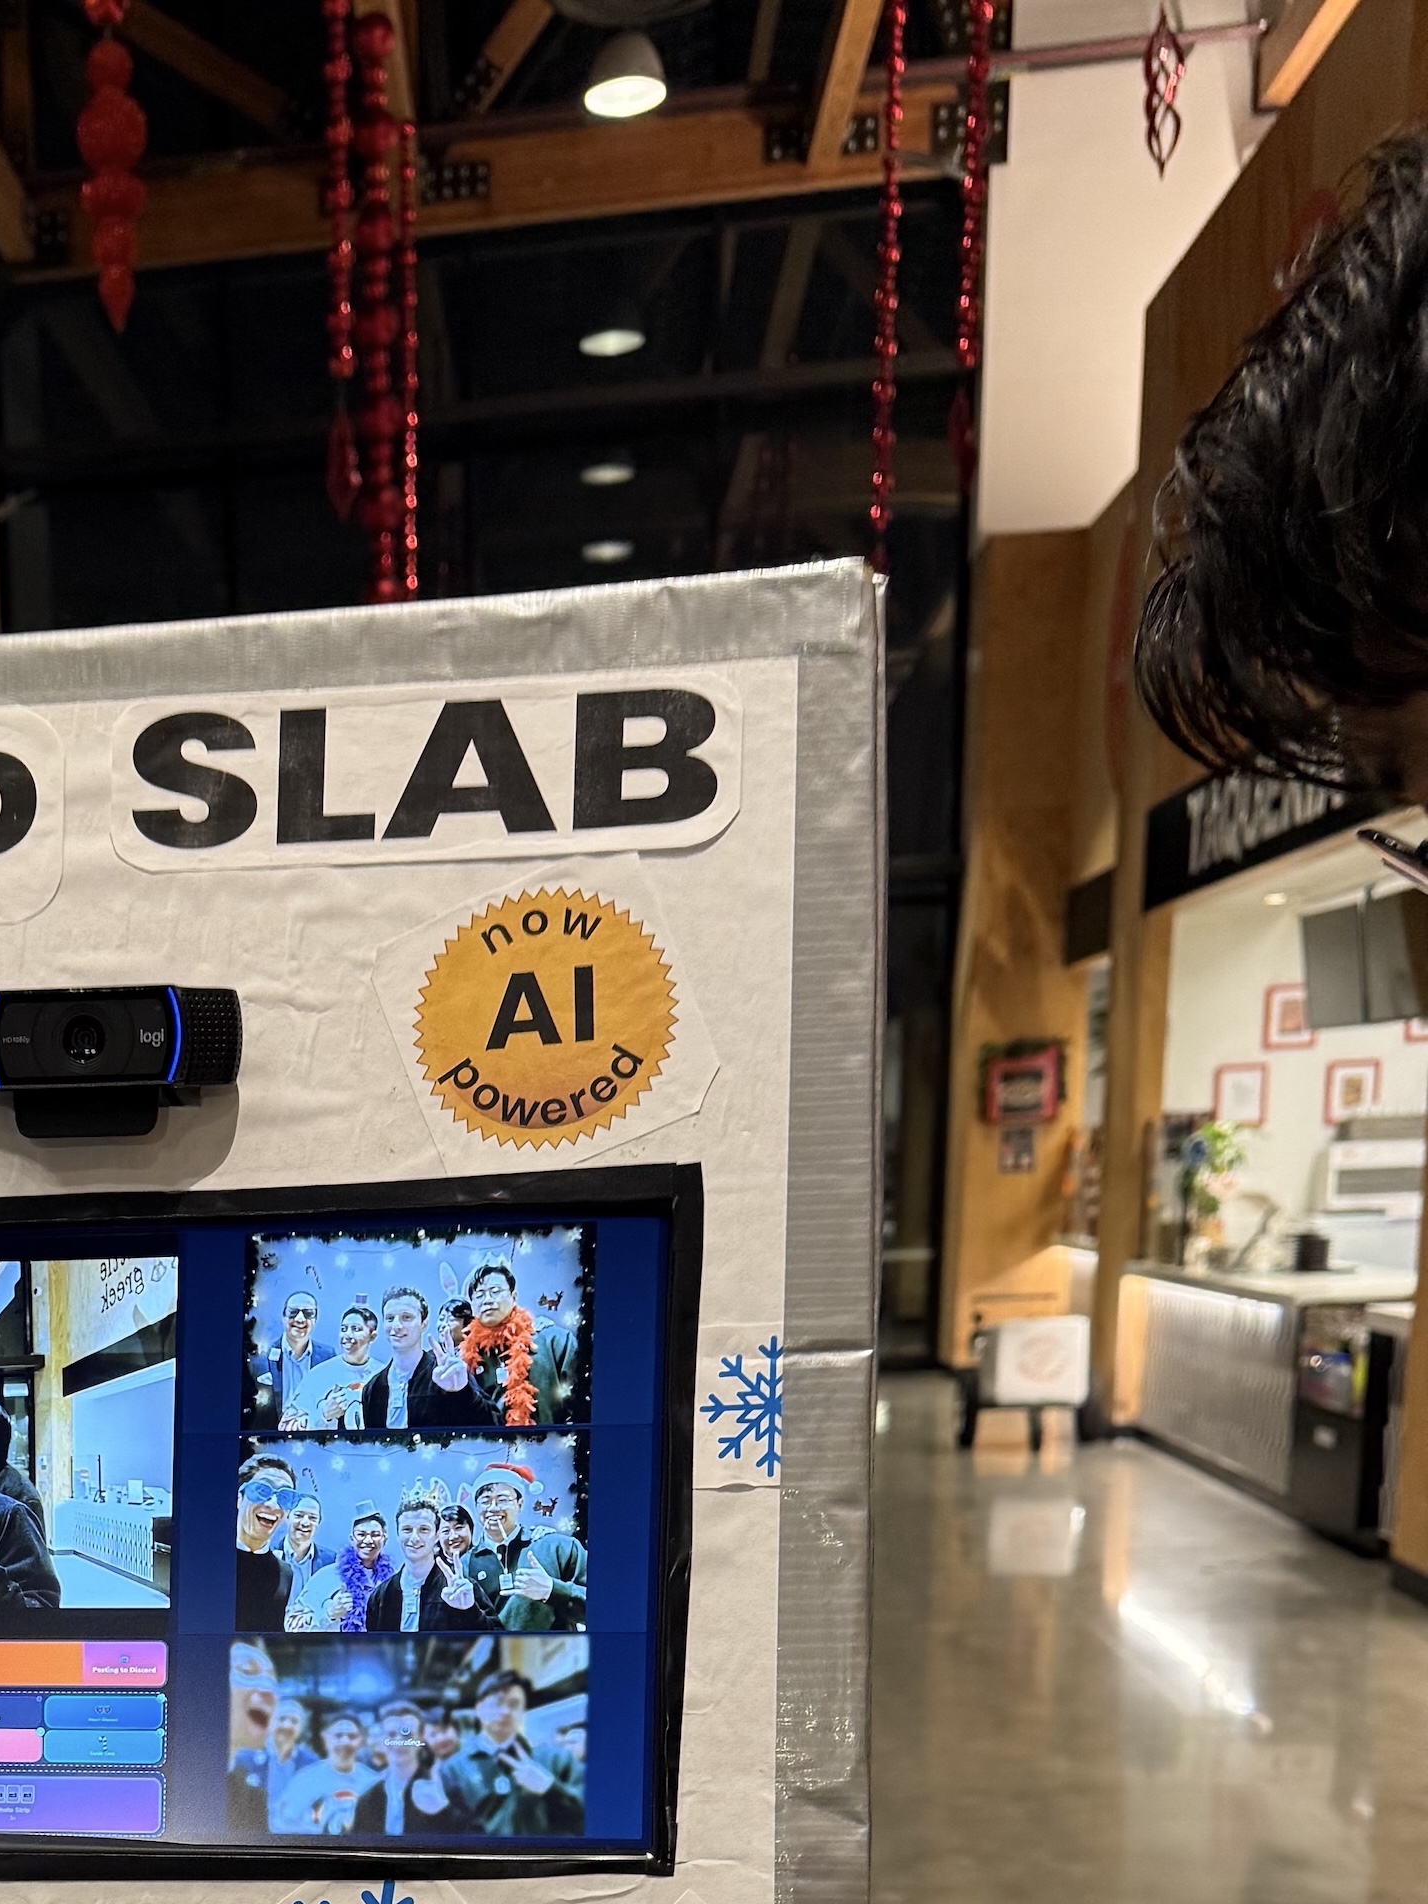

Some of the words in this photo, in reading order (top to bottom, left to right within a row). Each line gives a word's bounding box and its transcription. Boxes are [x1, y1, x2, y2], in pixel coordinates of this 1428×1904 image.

[130, 688, 720, 848] SLAB
[1187, 766, 1344, 877] TAQUER
[481, 907, 602, 955] now
[139, 1028, 165, 1048] logi
[485, 964, 594, 1051] AI
[437, 1043, 644, 1127] powered
[92, 1666, 119, 1674] Posting
[129, 1666, 157, 1674] Discord
